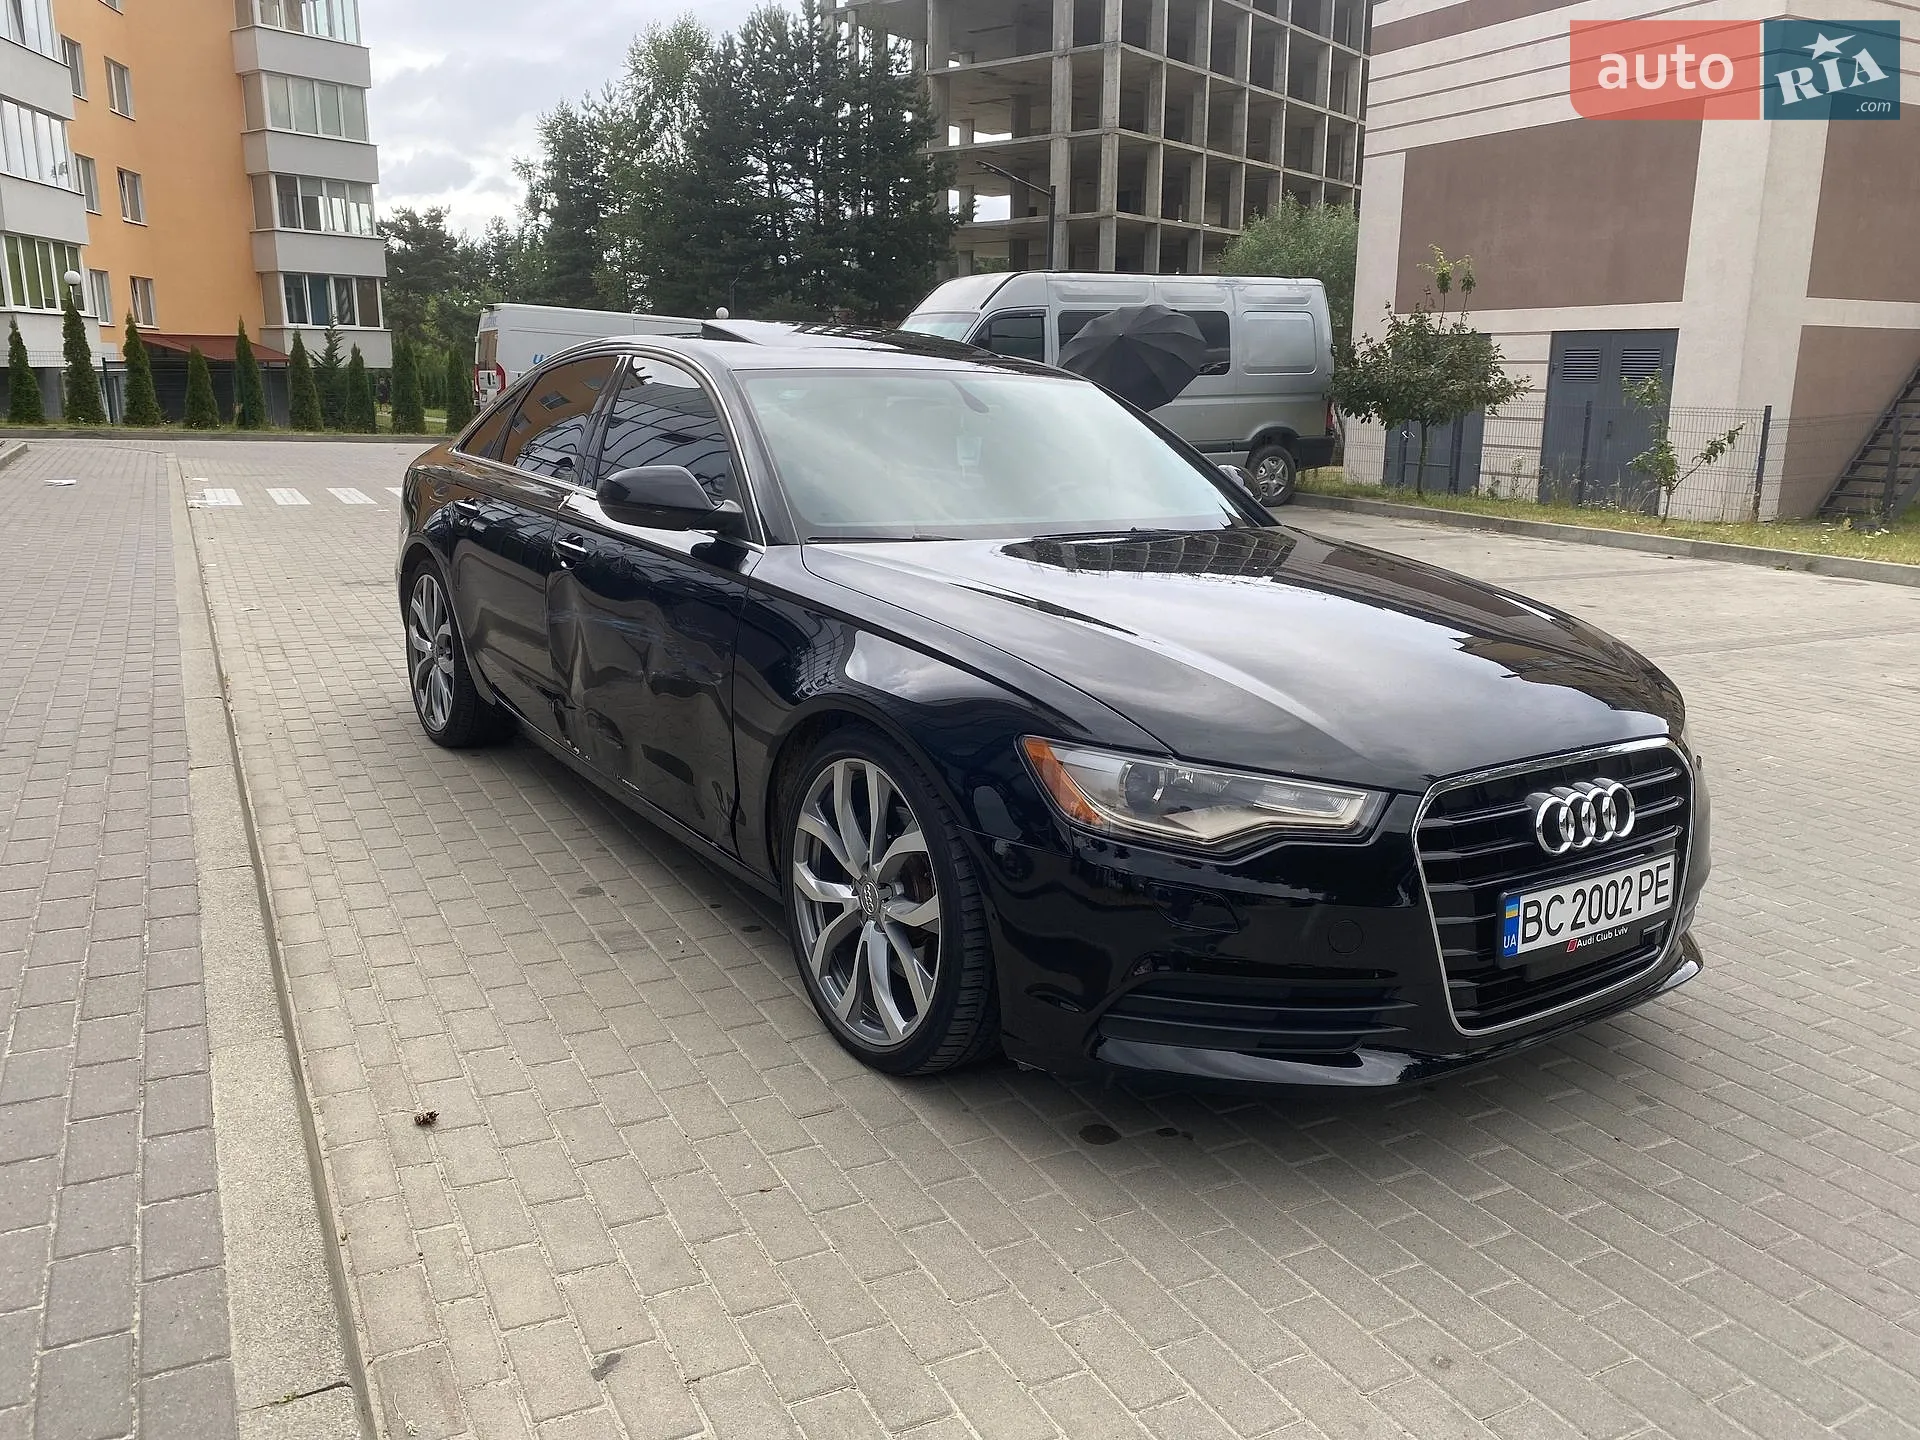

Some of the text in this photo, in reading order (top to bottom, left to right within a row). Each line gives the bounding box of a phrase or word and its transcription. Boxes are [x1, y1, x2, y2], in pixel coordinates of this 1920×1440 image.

[1503, 934, 1517, 949] UA
[1576, 926, 1629, 948] Audi Club Lviv
